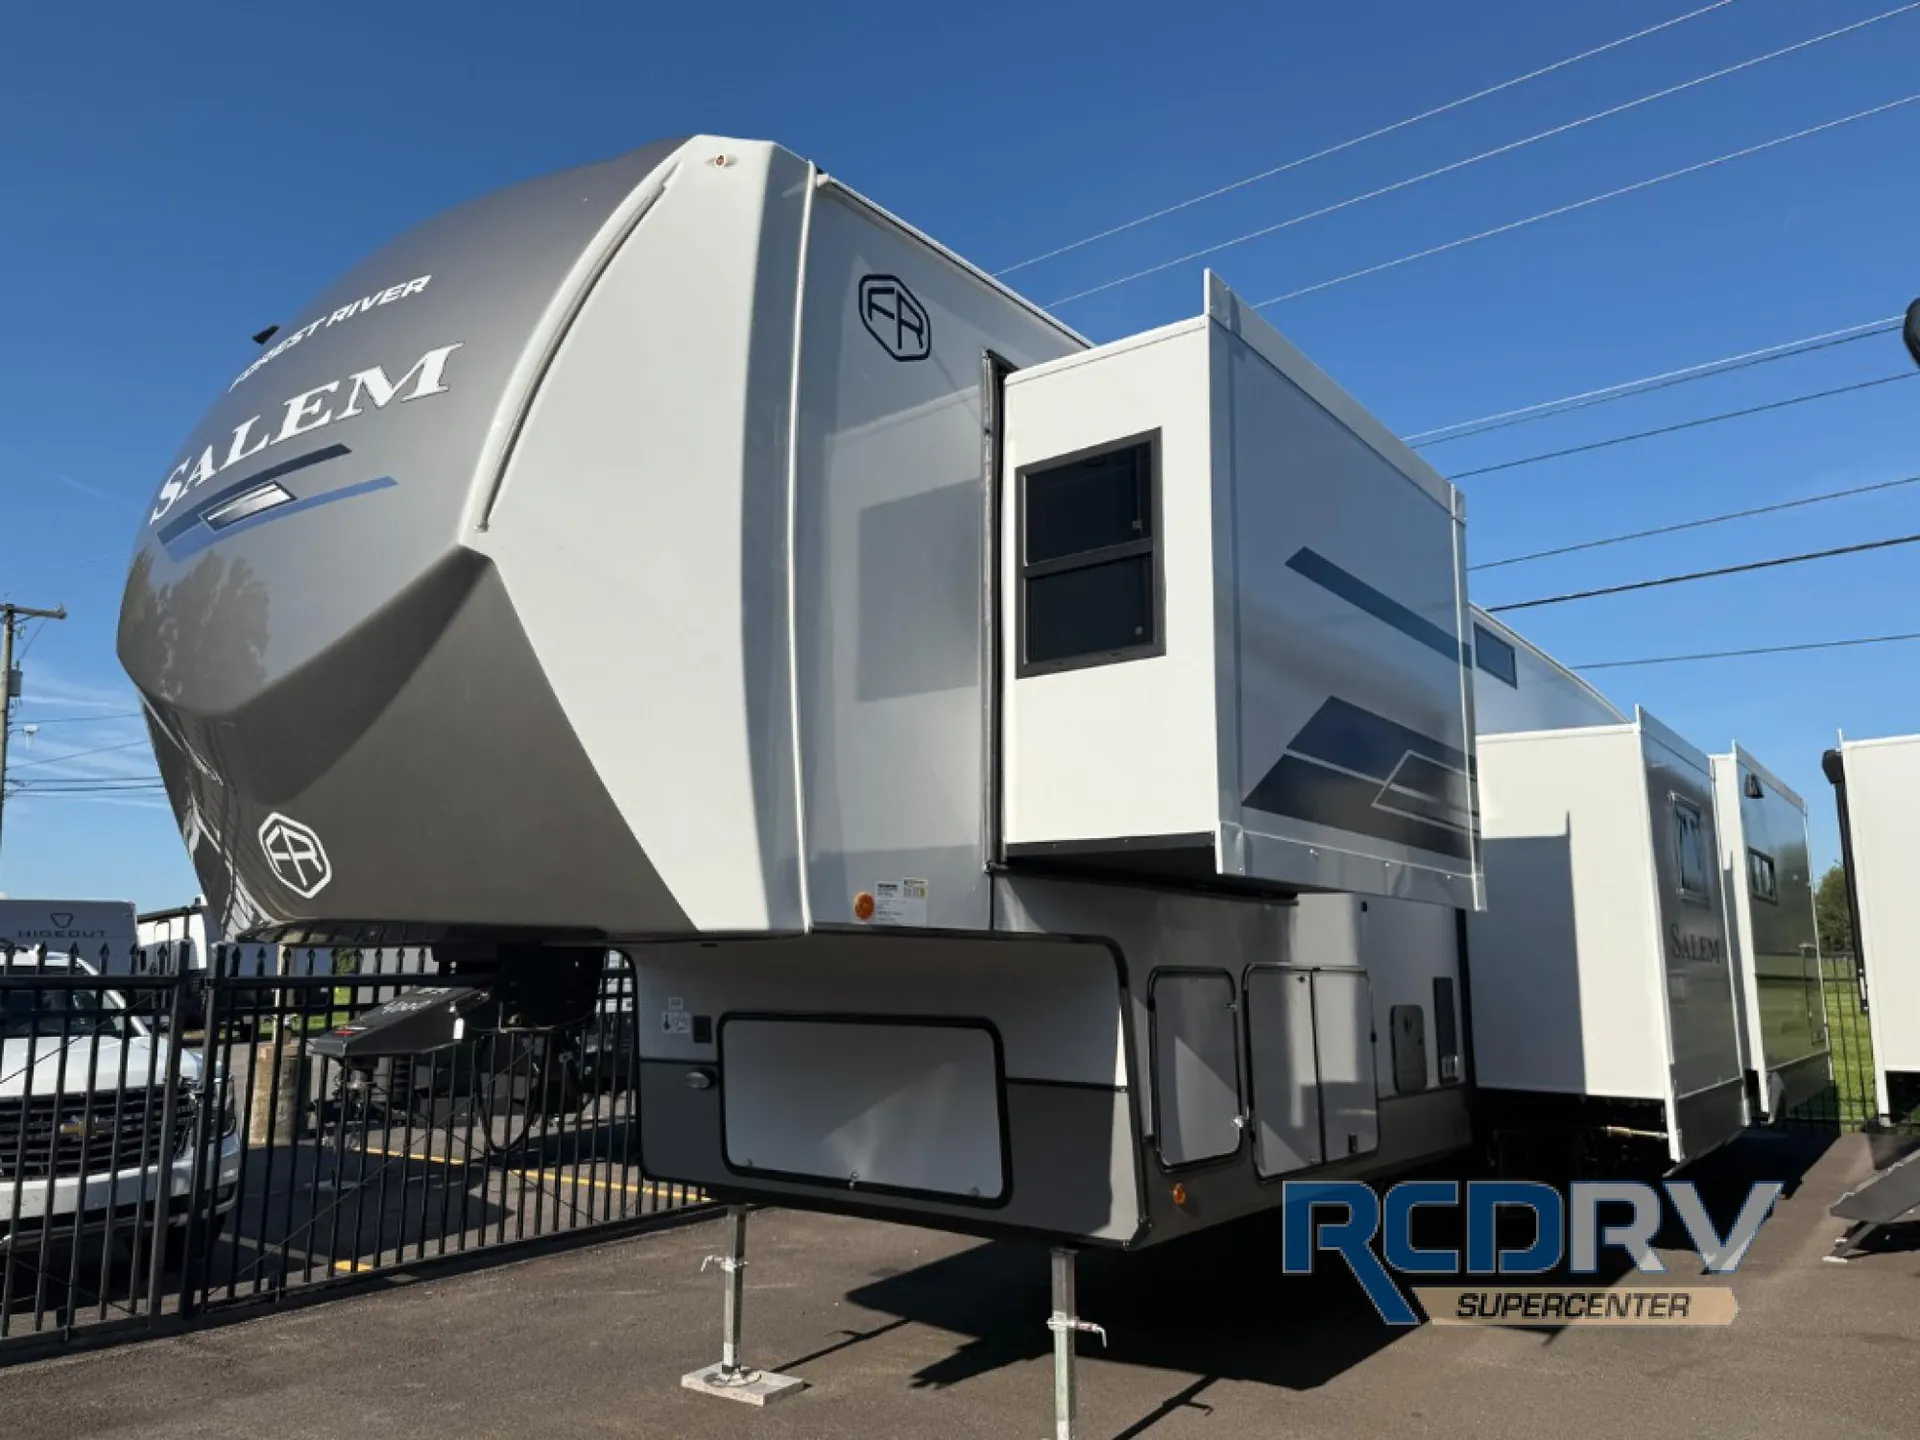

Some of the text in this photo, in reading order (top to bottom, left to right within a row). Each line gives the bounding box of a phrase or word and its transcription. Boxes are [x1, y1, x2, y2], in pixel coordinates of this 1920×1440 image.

[325, 274, 432, 328] RIVER
[150, 340, 465, 525] SALEM
[18, 929, 108, 939] HIDEOUT
